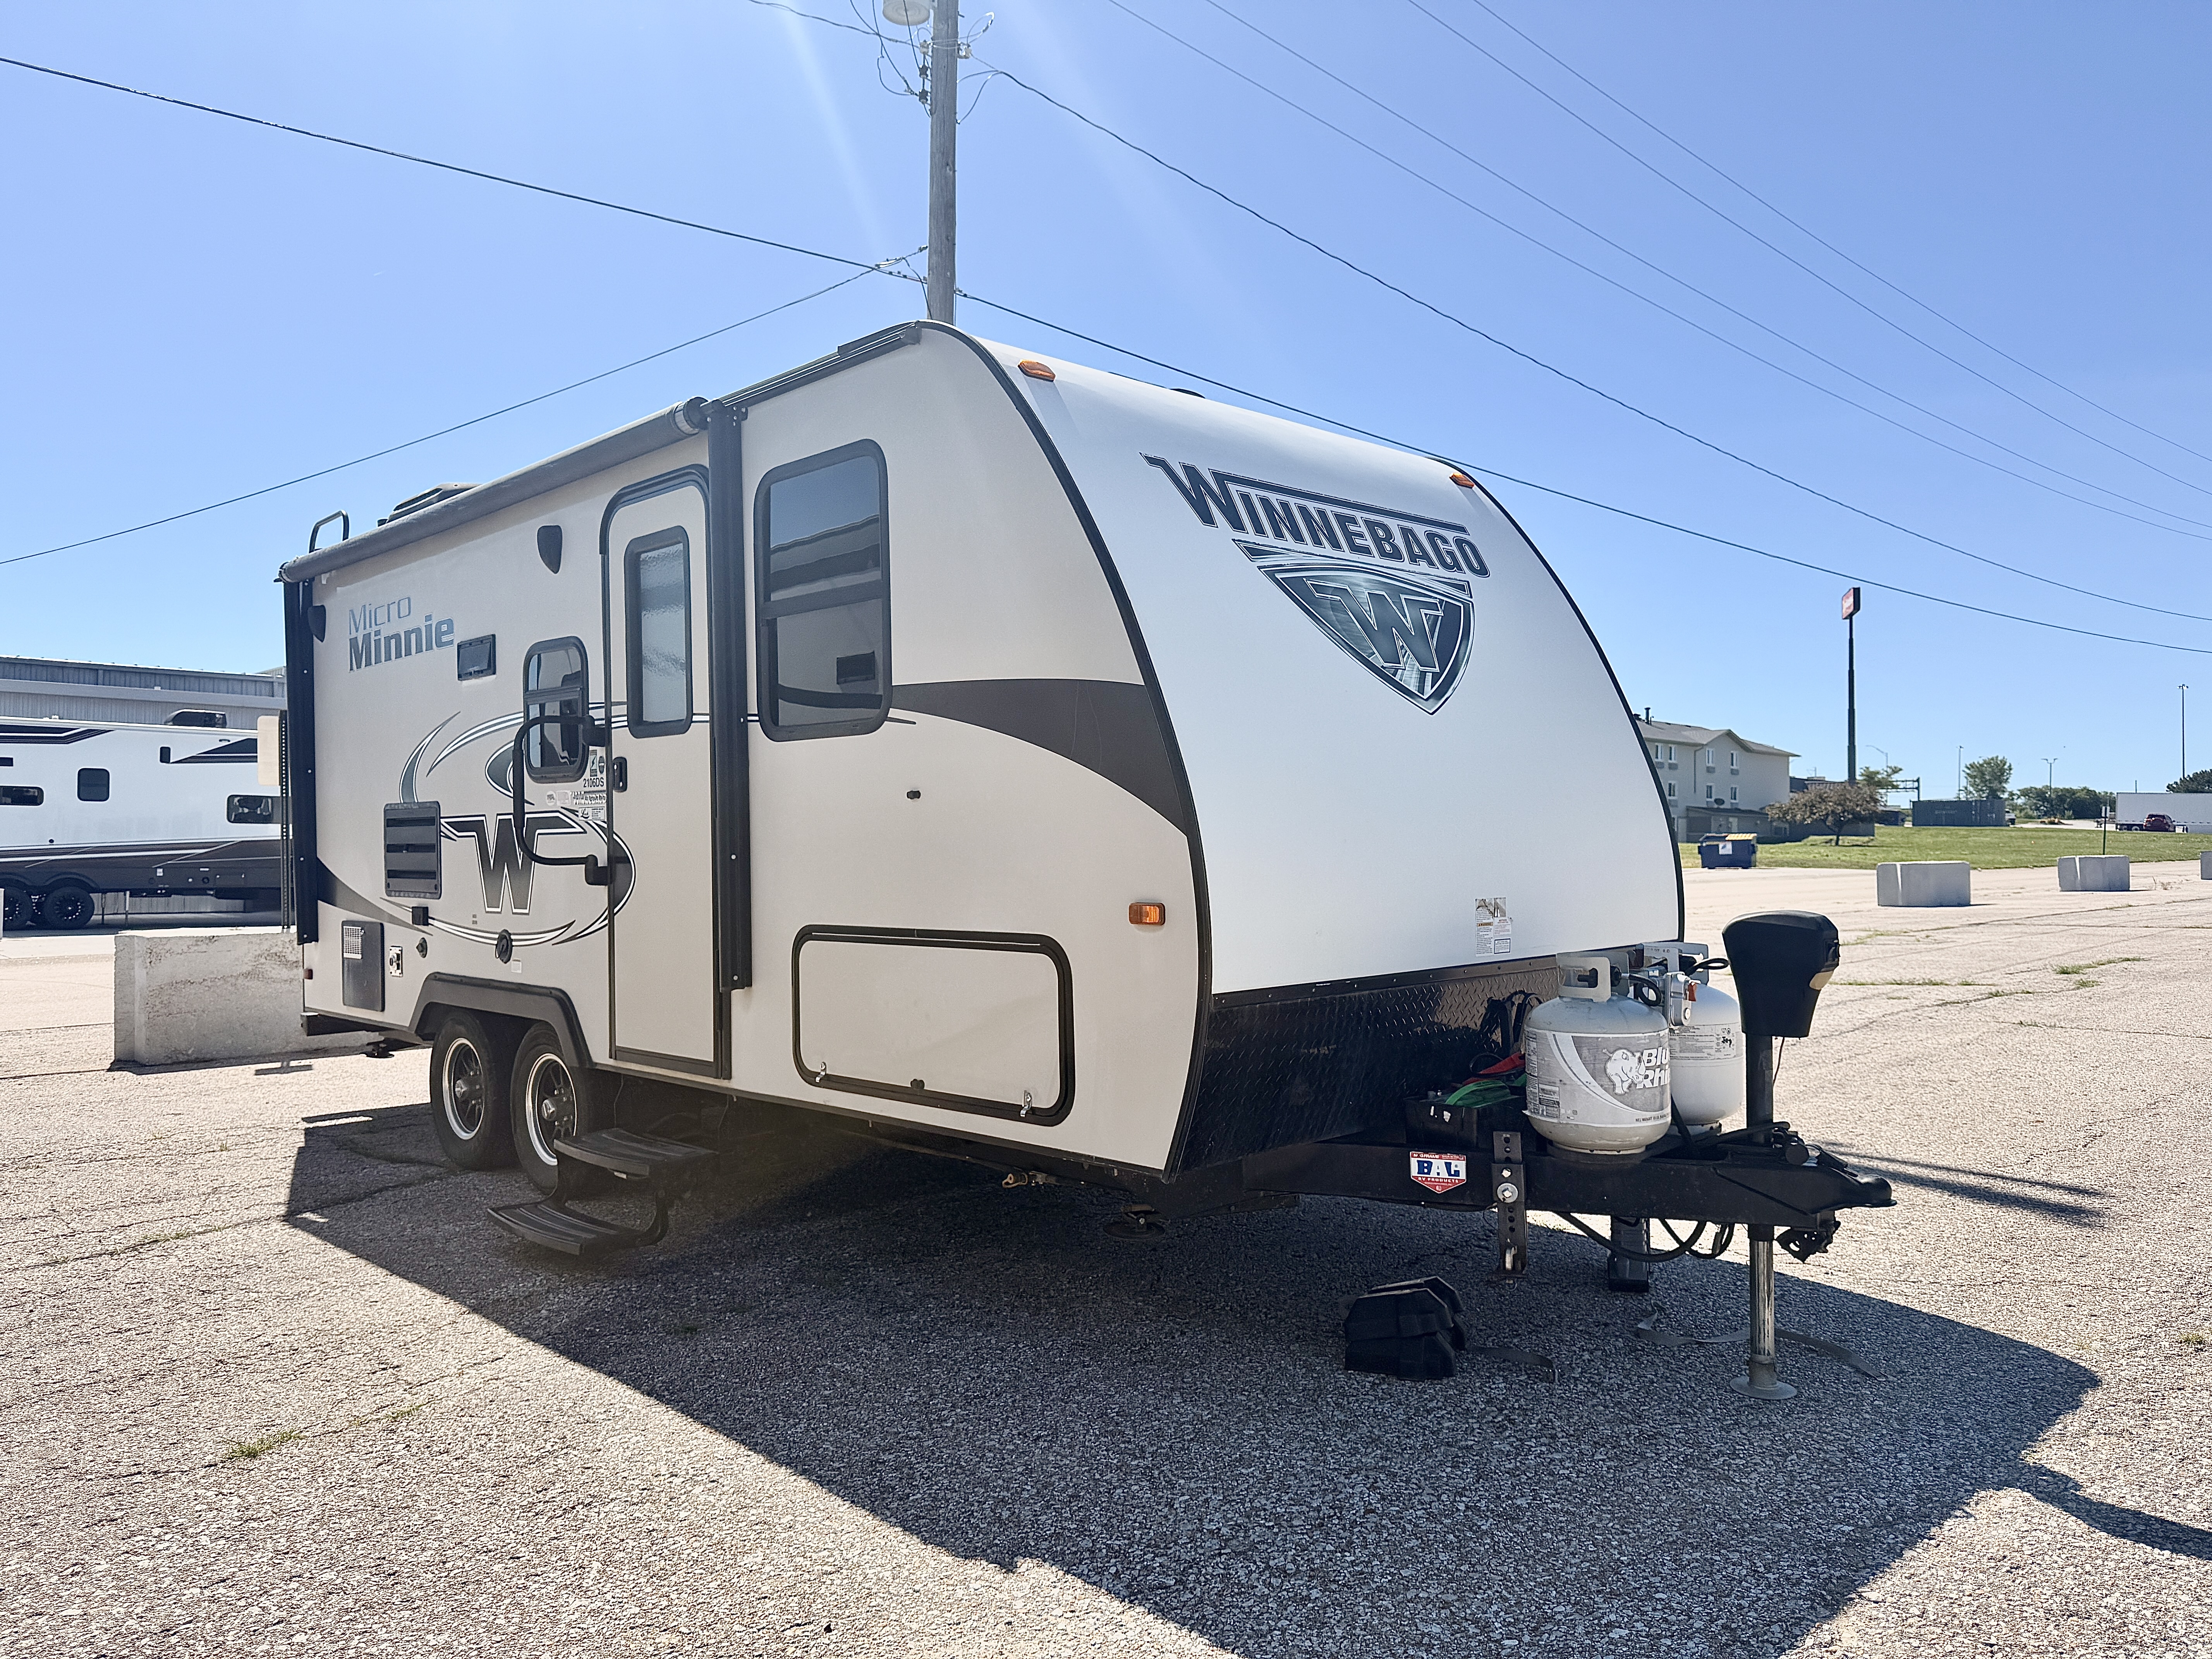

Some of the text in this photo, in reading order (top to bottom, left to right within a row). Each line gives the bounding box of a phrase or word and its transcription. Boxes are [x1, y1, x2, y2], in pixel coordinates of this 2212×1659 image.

[1140, 452, 1490, 578] WINNEBAGO
[349, 597, 411, 635] Micro
[1304, 578, 1444, 673] W
[349, 614, 455, 673] Minnie
[583, 777, 604, 788] 2106DS
[1417, 1159, 1460, 1177] BAL
